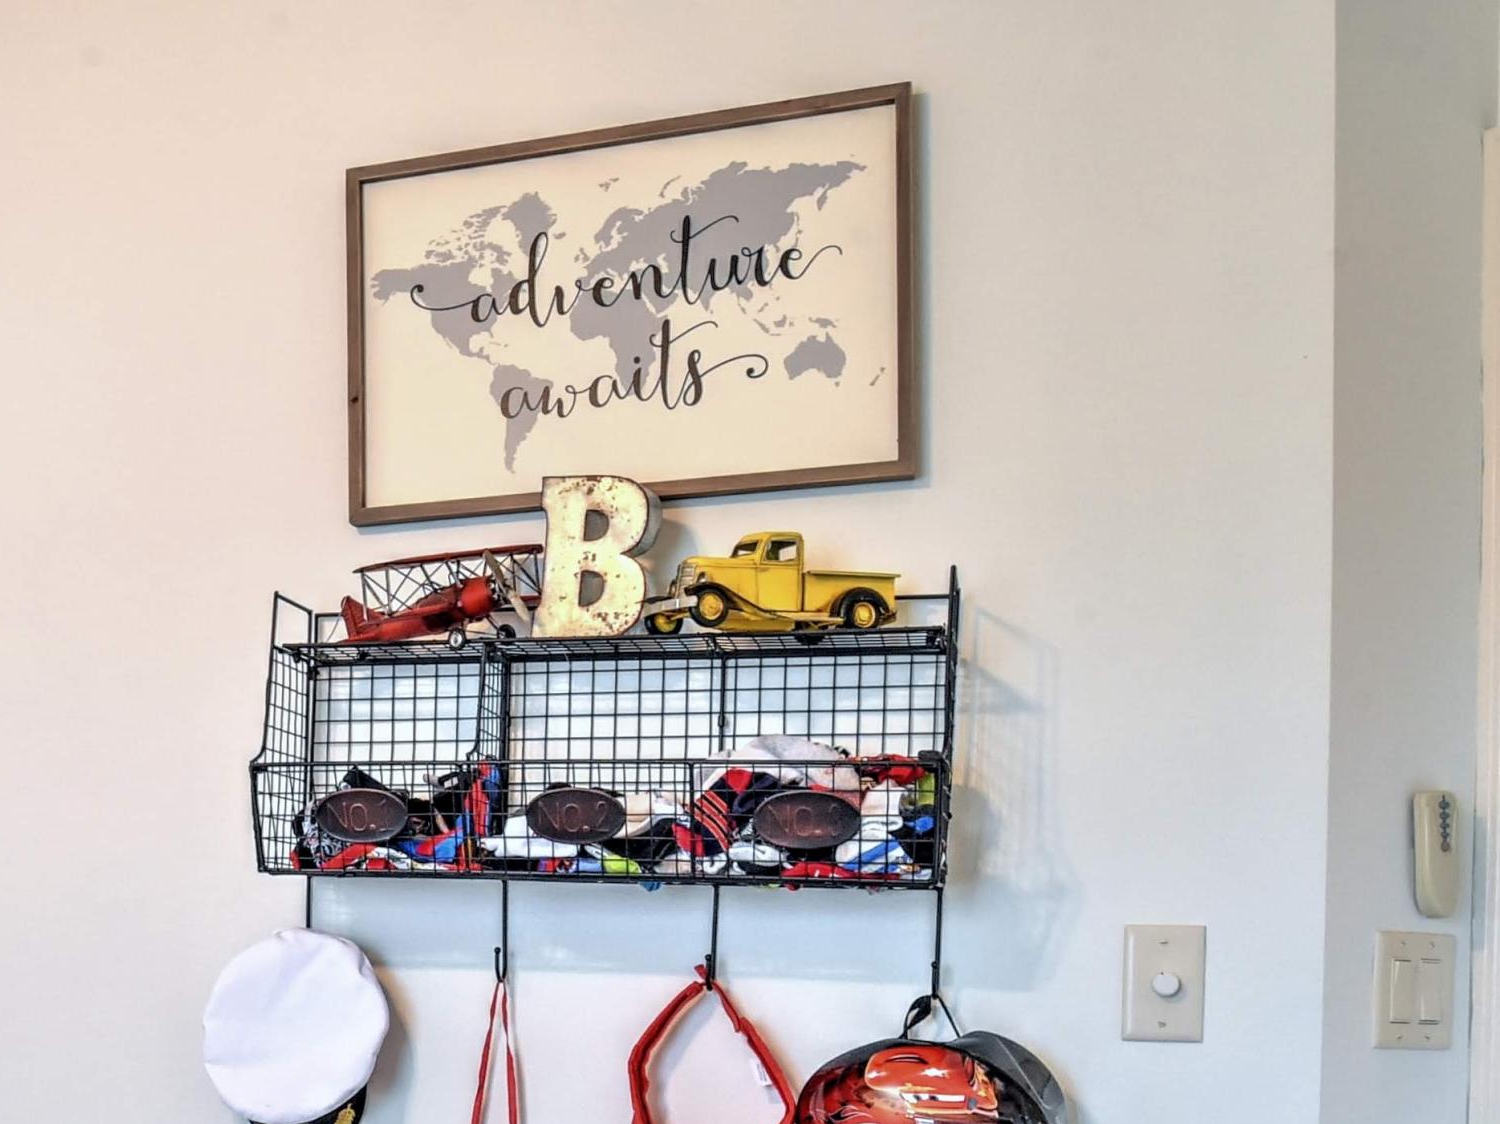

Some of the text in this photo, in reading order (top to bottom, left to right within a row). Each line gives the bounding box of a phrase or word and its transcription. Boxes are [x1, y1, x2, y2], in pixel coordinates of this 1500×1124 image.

[410, 214, 843, 328] adventure
[500, 319, 769, 420] awaits
[531, 475, 654, 638] B
[538, 800, 610, 833] NO.2
